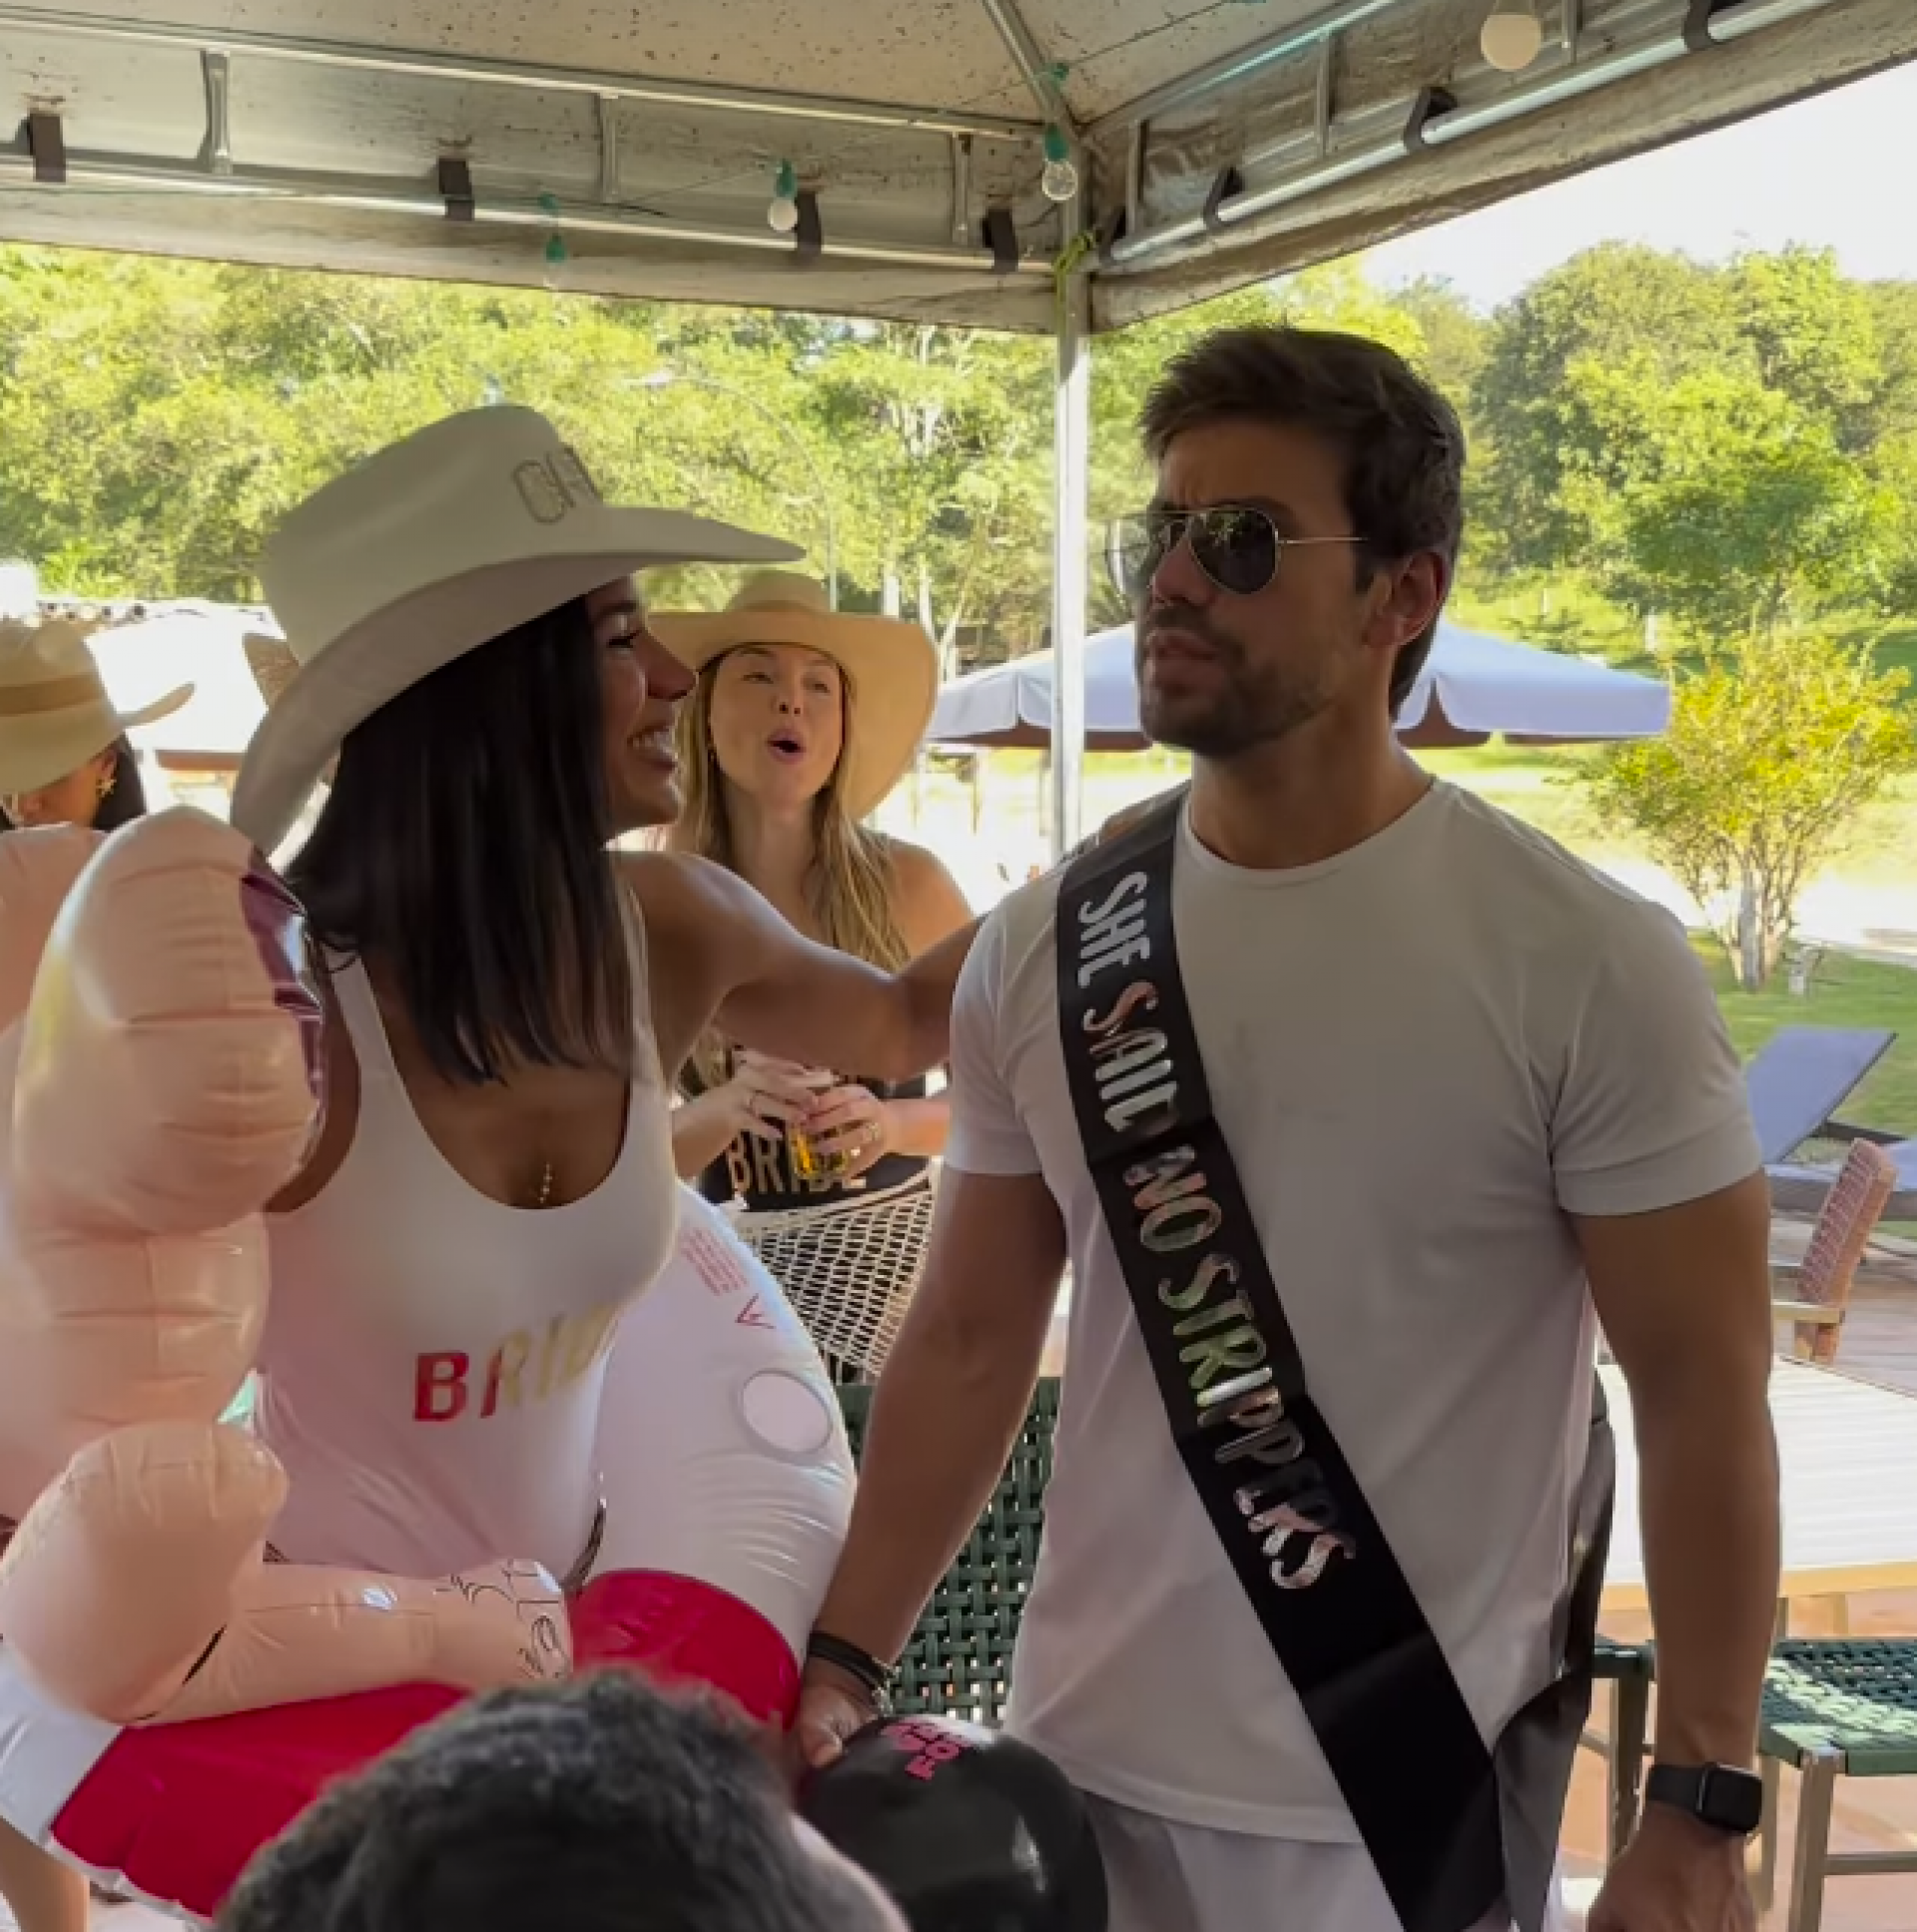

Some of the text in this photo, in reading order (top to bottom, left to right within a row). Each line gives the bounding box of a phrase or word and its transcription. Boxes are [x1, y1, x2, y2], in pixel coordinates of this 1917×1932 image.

[1077, 871, 1356, 1590] SHE SAID NO STRIPPERS
